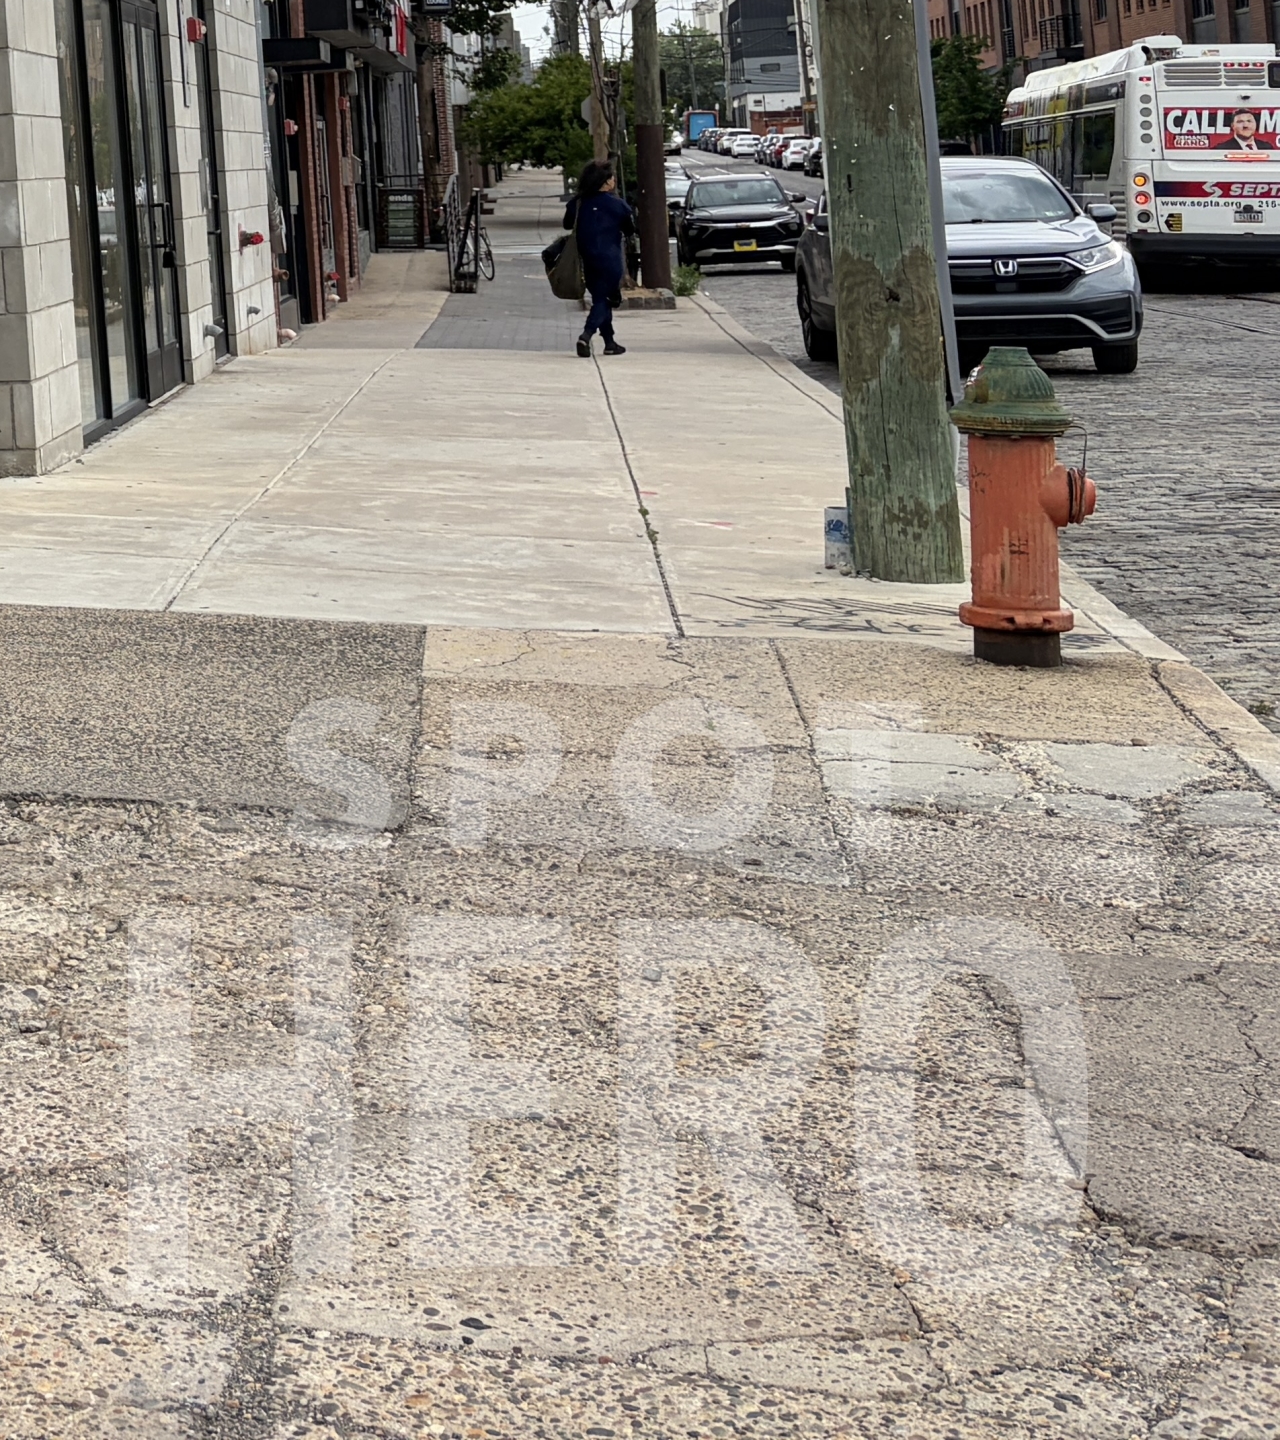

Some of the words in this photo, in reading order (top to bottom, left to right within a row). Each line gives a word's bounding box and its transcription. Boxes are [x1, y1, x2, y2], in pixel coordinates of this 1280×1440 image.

[1166, 109, 1231, 134] CALL
[1229, 183, 1280, 196] SEPT
[1161, 200, 1242, 209] www.septa.org
